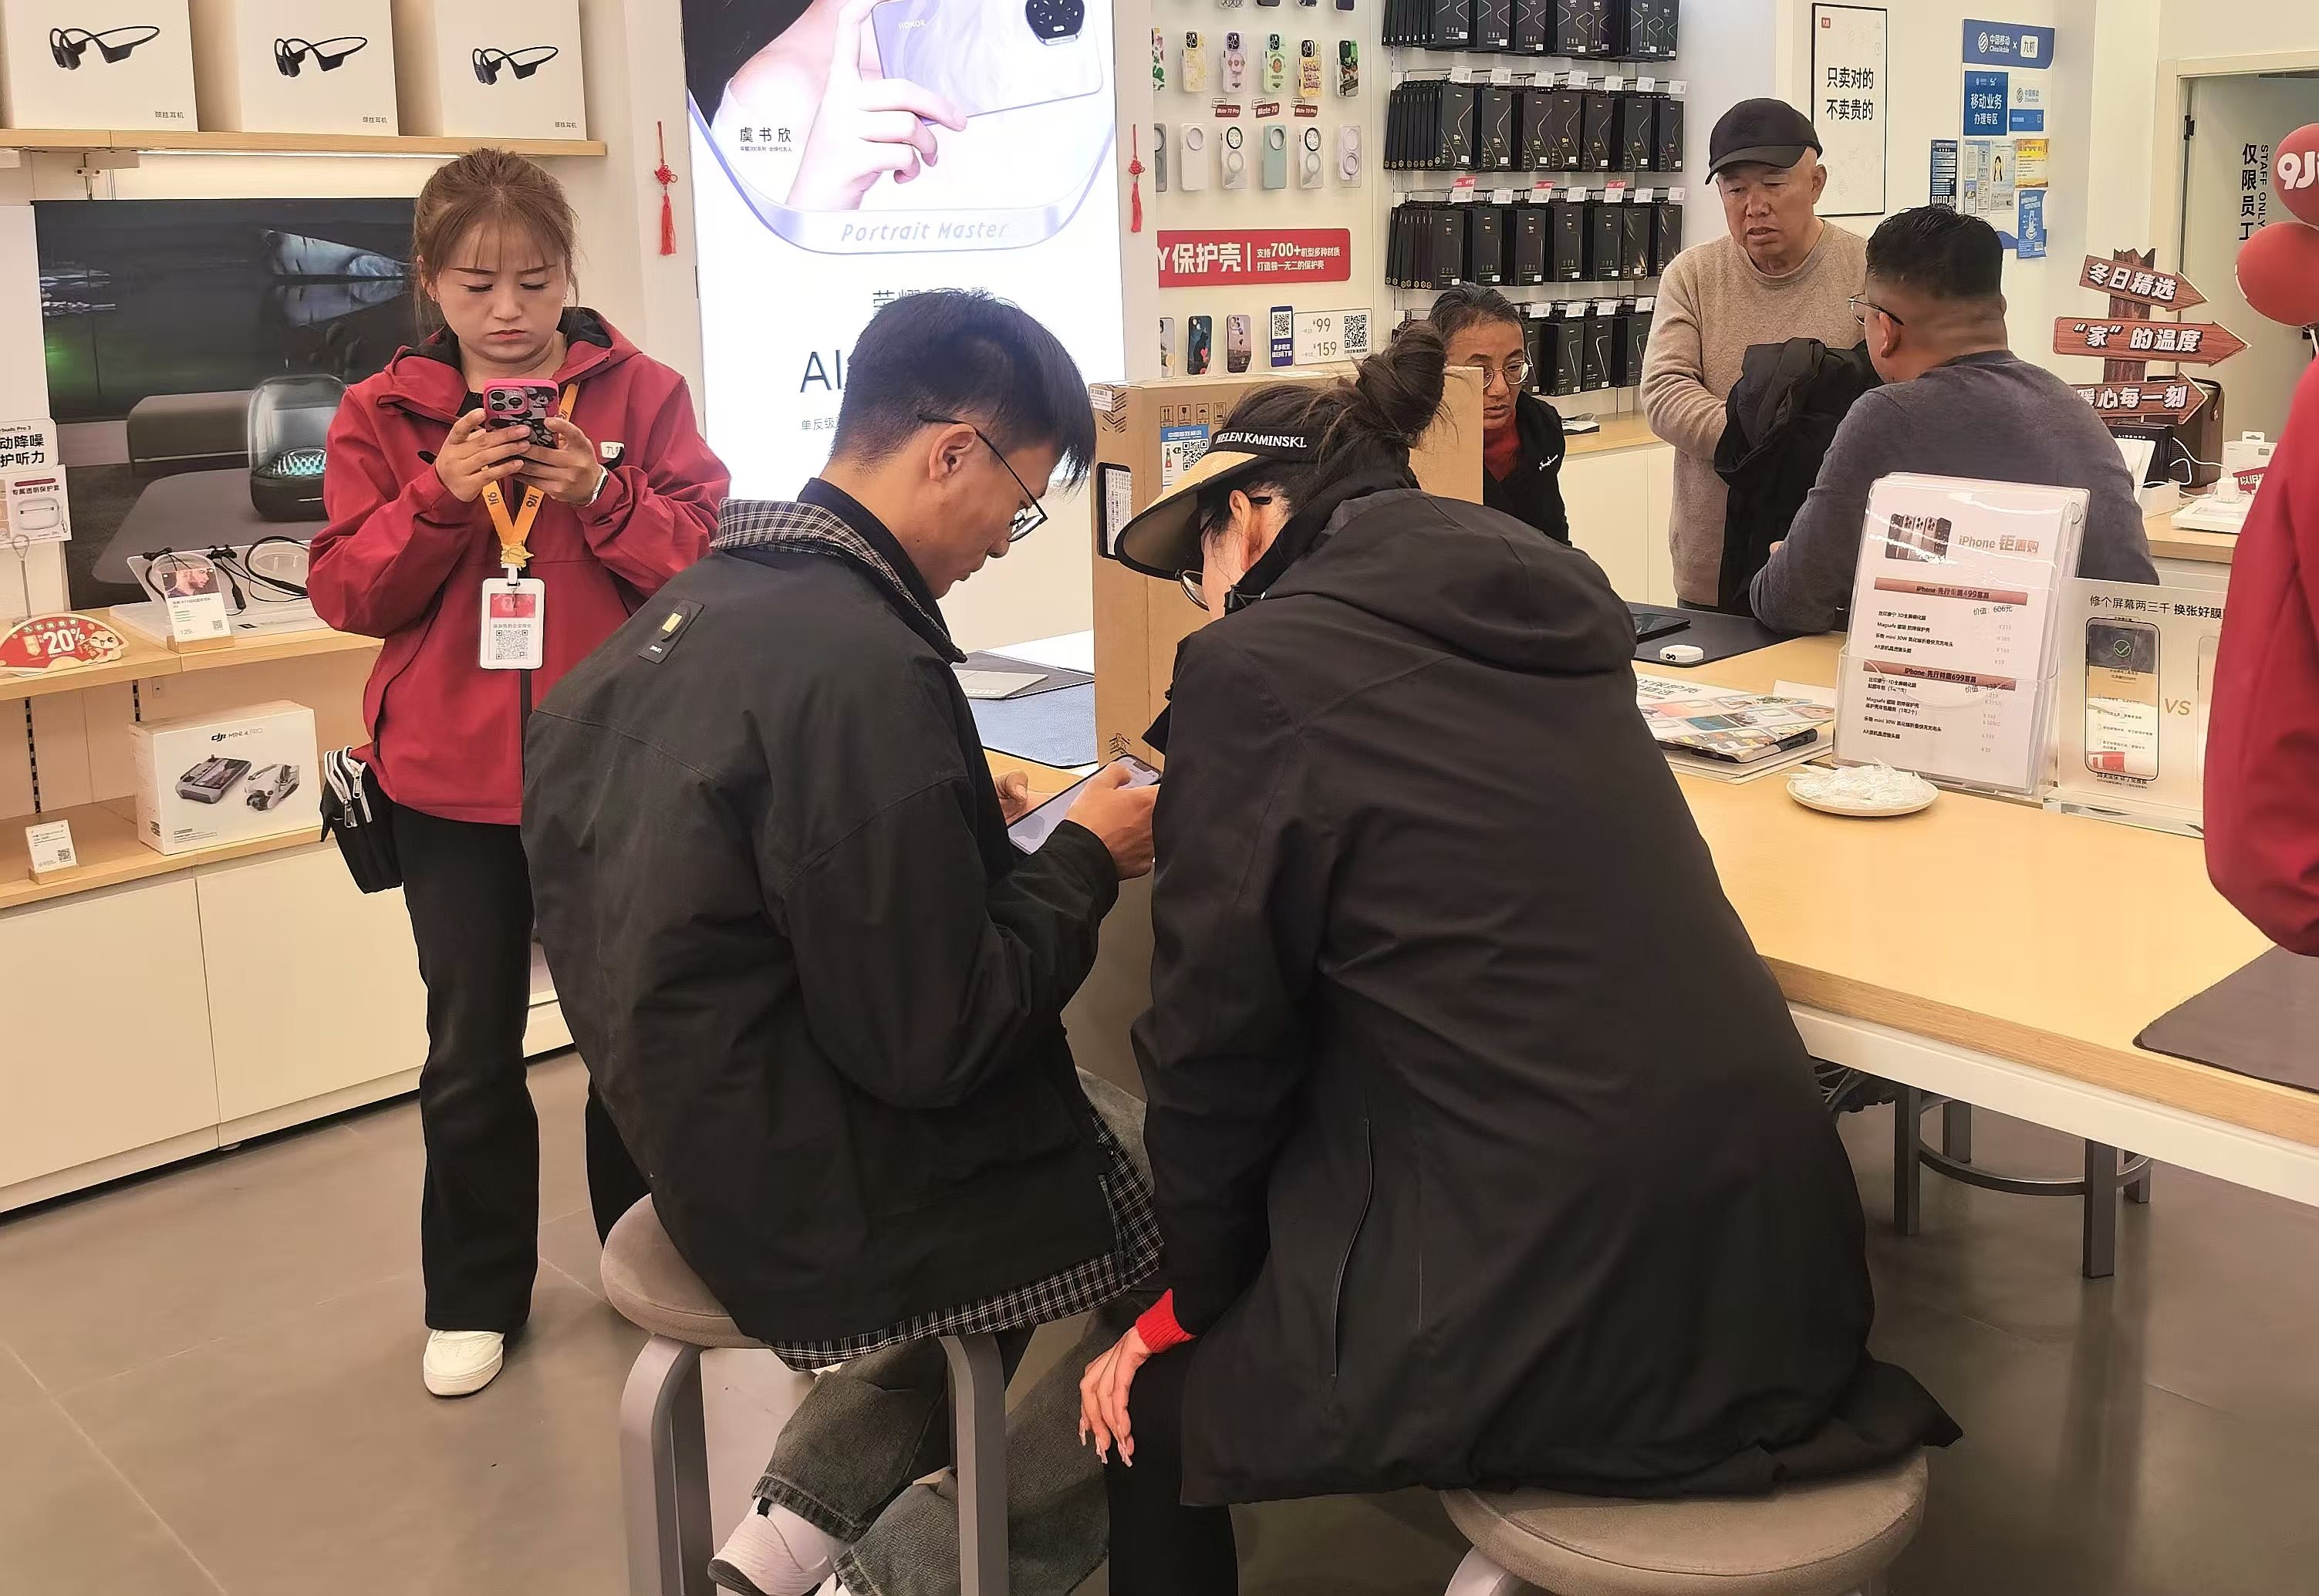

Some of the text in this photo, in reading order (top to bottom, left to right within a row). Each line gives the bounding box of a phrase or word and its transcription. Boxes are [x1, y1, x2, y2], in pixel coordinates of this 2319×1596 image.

[899, 19, 926, 30] HONOR
[1990, 34, 2010, 46] 中国移动
[2023, 40, 2035, 54] 九机
[1826, 66, 1874, 89] 只卖对的
[1826, 98, 1874, 120] 不卖贵的
[1970, 93, 2003, 110] 移动业务
[1974, 113, 1998, 125] 办理专区
[741, 127, 792, 143] 虞书欣
[2277, 150, 2319, 191] 9J
[2239, 143, 2258, 241] 仅限员工
[2258, 144, 2269, 228] STAFF ONLY
[841, 222, 1009, 241] Portrait Master
[1257, 243, 1341, 258] 支持700+机型多种材质
[1257, 260, 1325, 272] 打造独一无二的保护壳
[2088, 262, 2178, 302] 冬日精选
[800, 349, 842, 393] AI
[801, 417, 840, 431] 单反级
[0, 434, 45, 450] 动降噪
[1215, 432, 1244, 444] HELEN
[0, 450, 45, 467] 护听力
[1958, 534, 1996, 550] iPhone
[1916, 585, 1936, 594] iPhone
[2090, 595, 2225, 619] 修个屏幕两三千 换张好膜
[42, 627, 86, 655] 20%
[1904, 666, 1926, 677] iPhone
[2164, 698, 2192, 716] VS
